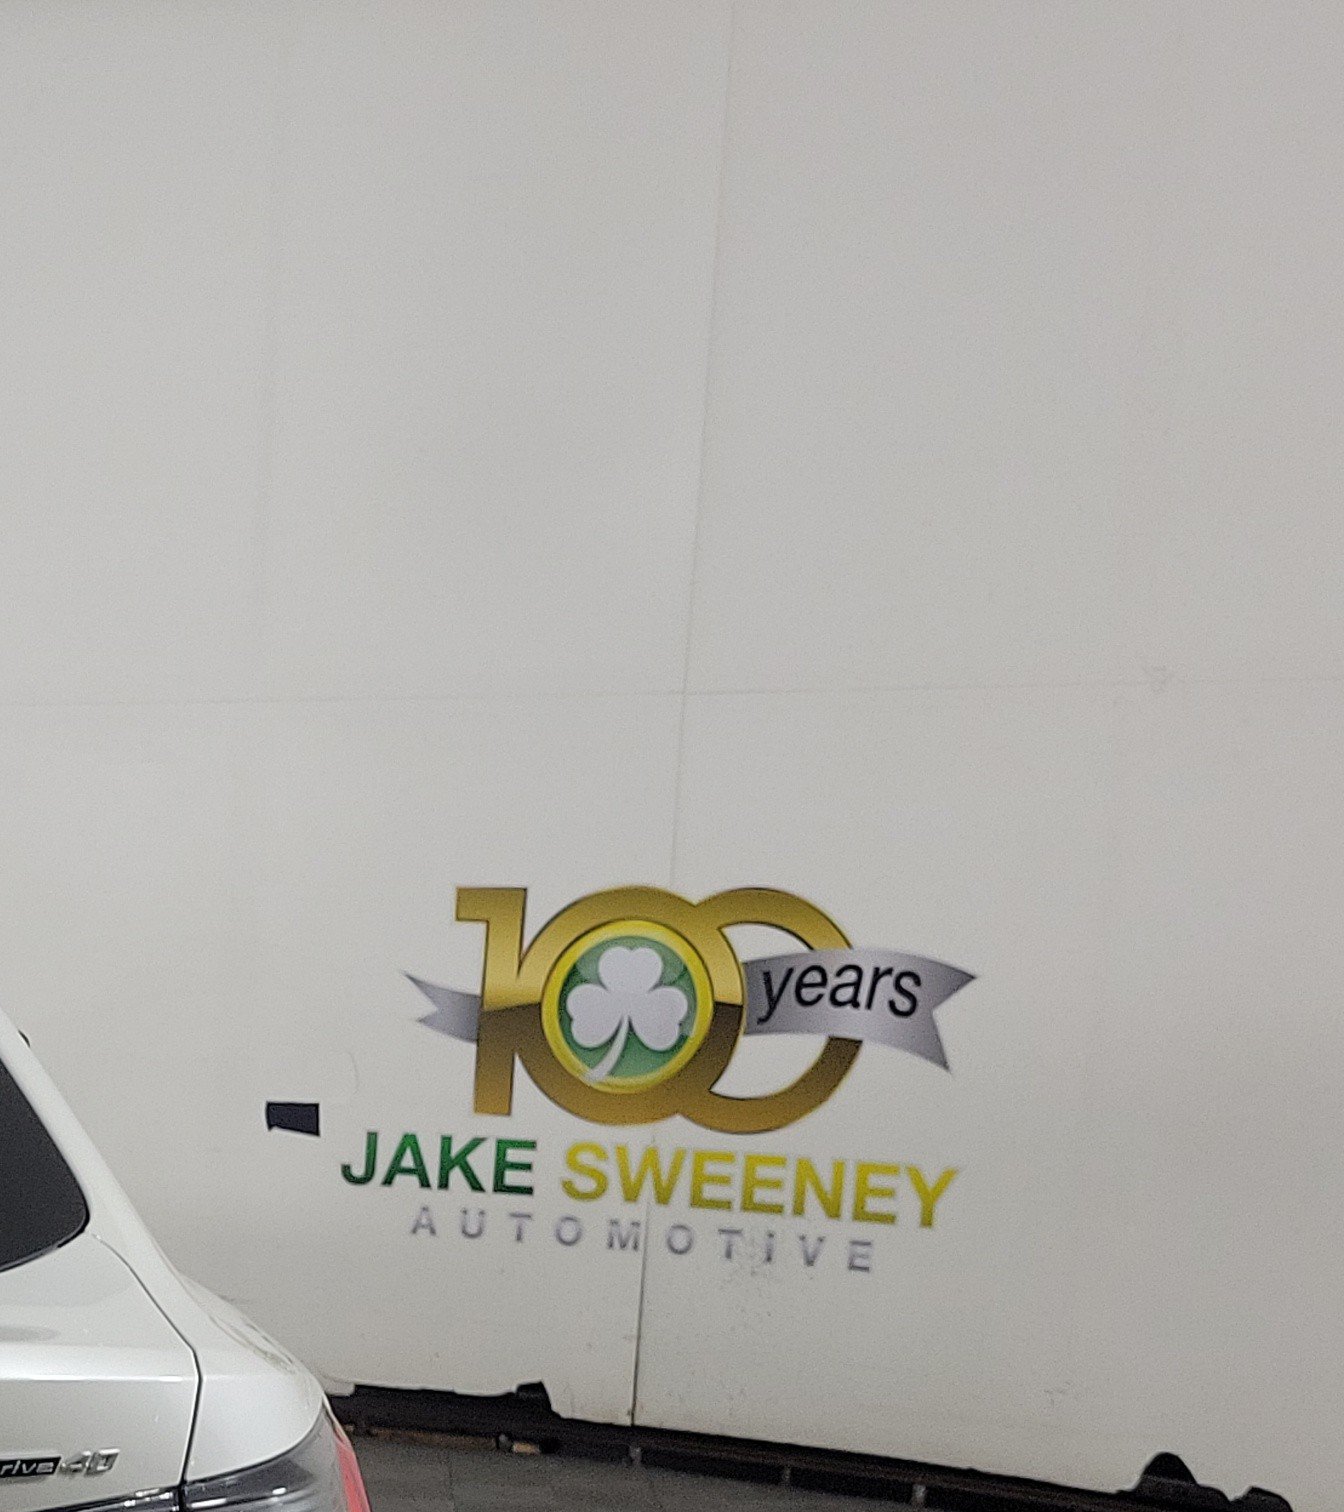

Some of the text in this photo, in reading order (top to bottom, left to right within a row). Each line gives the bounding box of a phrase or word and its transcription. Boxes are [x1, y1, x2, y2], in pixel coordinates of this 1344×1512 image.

[456, 885, 863, 1134] 100
[756, 960, 923, 1027] years
[340, 1131, 958, 1228] JAKE SWEENEY
[411, 1206, 874, 1273] AUTOMOTIVE
